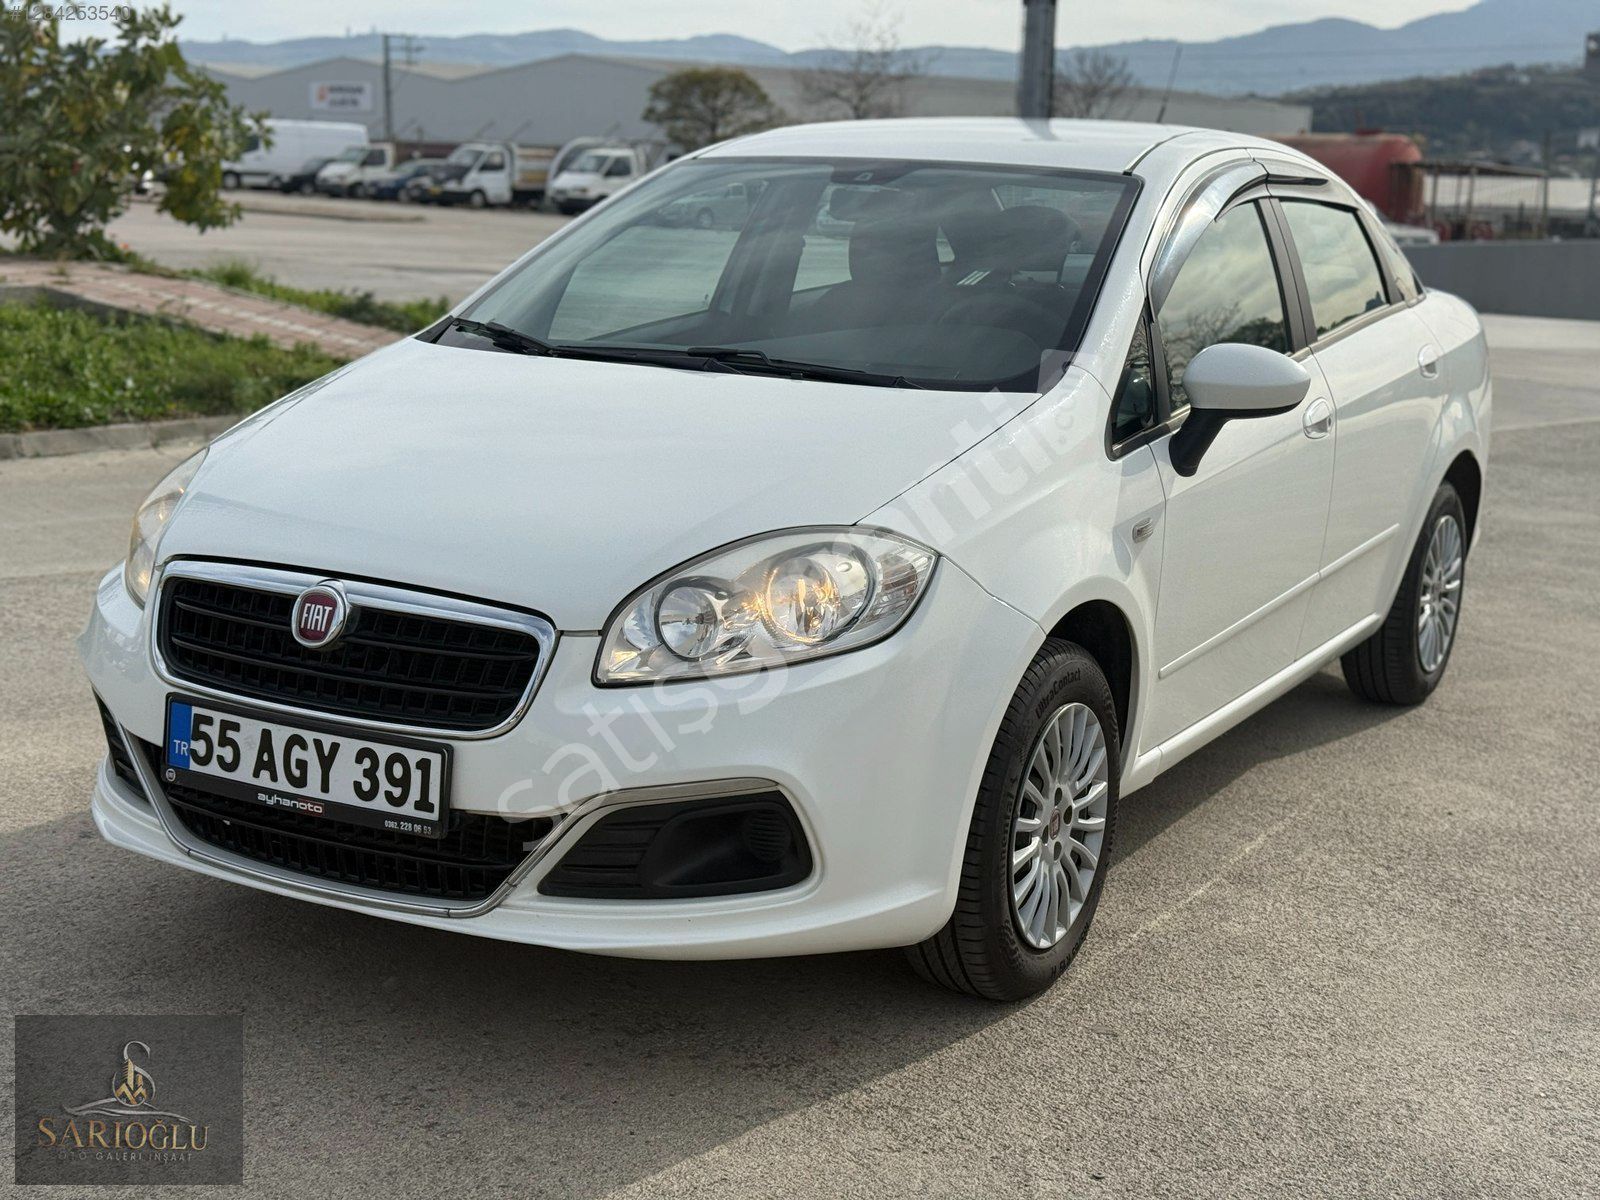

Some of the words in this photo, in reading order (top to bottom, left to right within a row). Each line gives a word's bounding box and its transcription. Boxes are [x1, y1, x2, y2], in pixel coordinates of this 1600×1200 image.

[301, 603, 333, 632] FIAT
[173, 738, 188, 756] TR
[189, 713, 241, 773] 55
[252, 728, 341, 794] AGY
[353, 746, 436, 814] 391
[257, 792, 323, 814] ayhanoto
